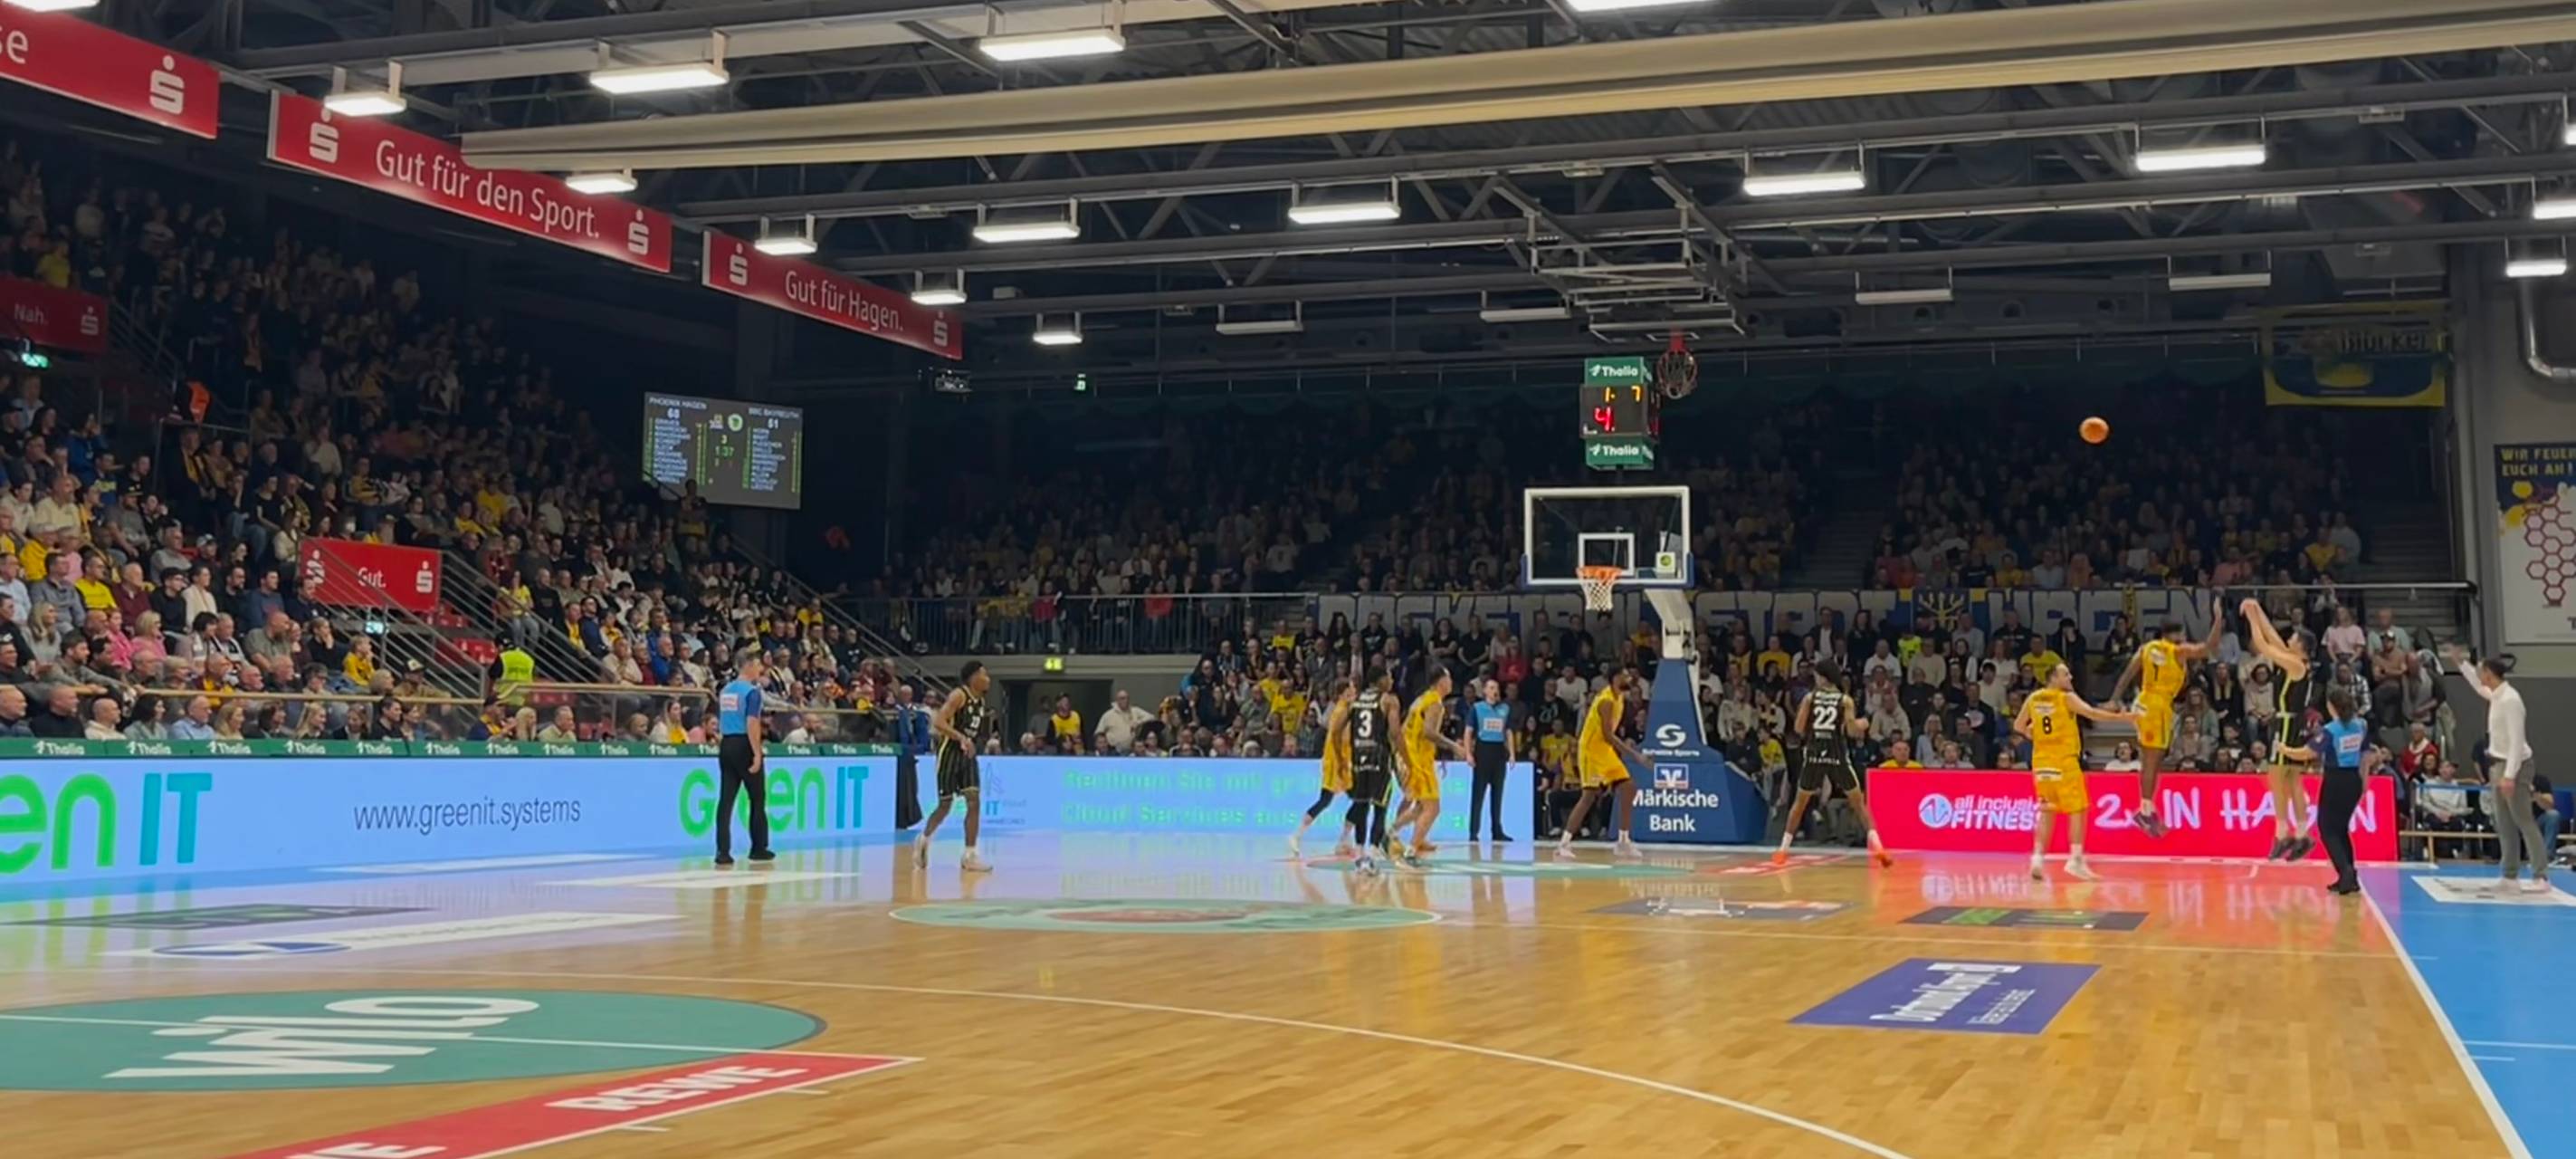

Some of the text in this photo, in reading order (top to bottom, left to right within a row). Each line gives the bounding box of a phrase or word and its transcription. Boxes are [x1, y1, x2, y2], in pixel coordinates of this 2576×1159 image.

[376, 139, 600, 239] Gut für den Sport.
[786, 271, 903, 331] Gut für Hagen.
[1602, 365, 1638, 377] Thalia
[1603, 445, 1639, 456] Thalia
[2501, 448, 2528, 461] WIR
[2502, 464, 2538, 476] EUCH
[358, 567, 386, 588] Gut.
[1358, 710, 1373, 738] 3
[1813, 706, 1838, 731] 22
[2042, 715, 2053, 735] 8
[46, 742, 85, 755] Thalia
[138, 742, 172, 755] Thalia
[220, 742, 252, 755] Thalia
[296, 742, 326, 755] Thalia
[365, 742, 394, 755] Thalia
[434, 742, 461, 755] Thalia
[835, 766, 870, 829] IT
[1954, 795, 1975, 810] all
[138, 771, 214, 866] IT
[354, 795, 581, 836] www.greenit.systems
[2162, 787, 2201, 829] IN
[2219, 789, 2378, 834] HAGN
[1649, 813, 1696, 832] Bank
[1951, 810, 2040, 831] FITNES
[544, 1065, 809, 1112] REWE
